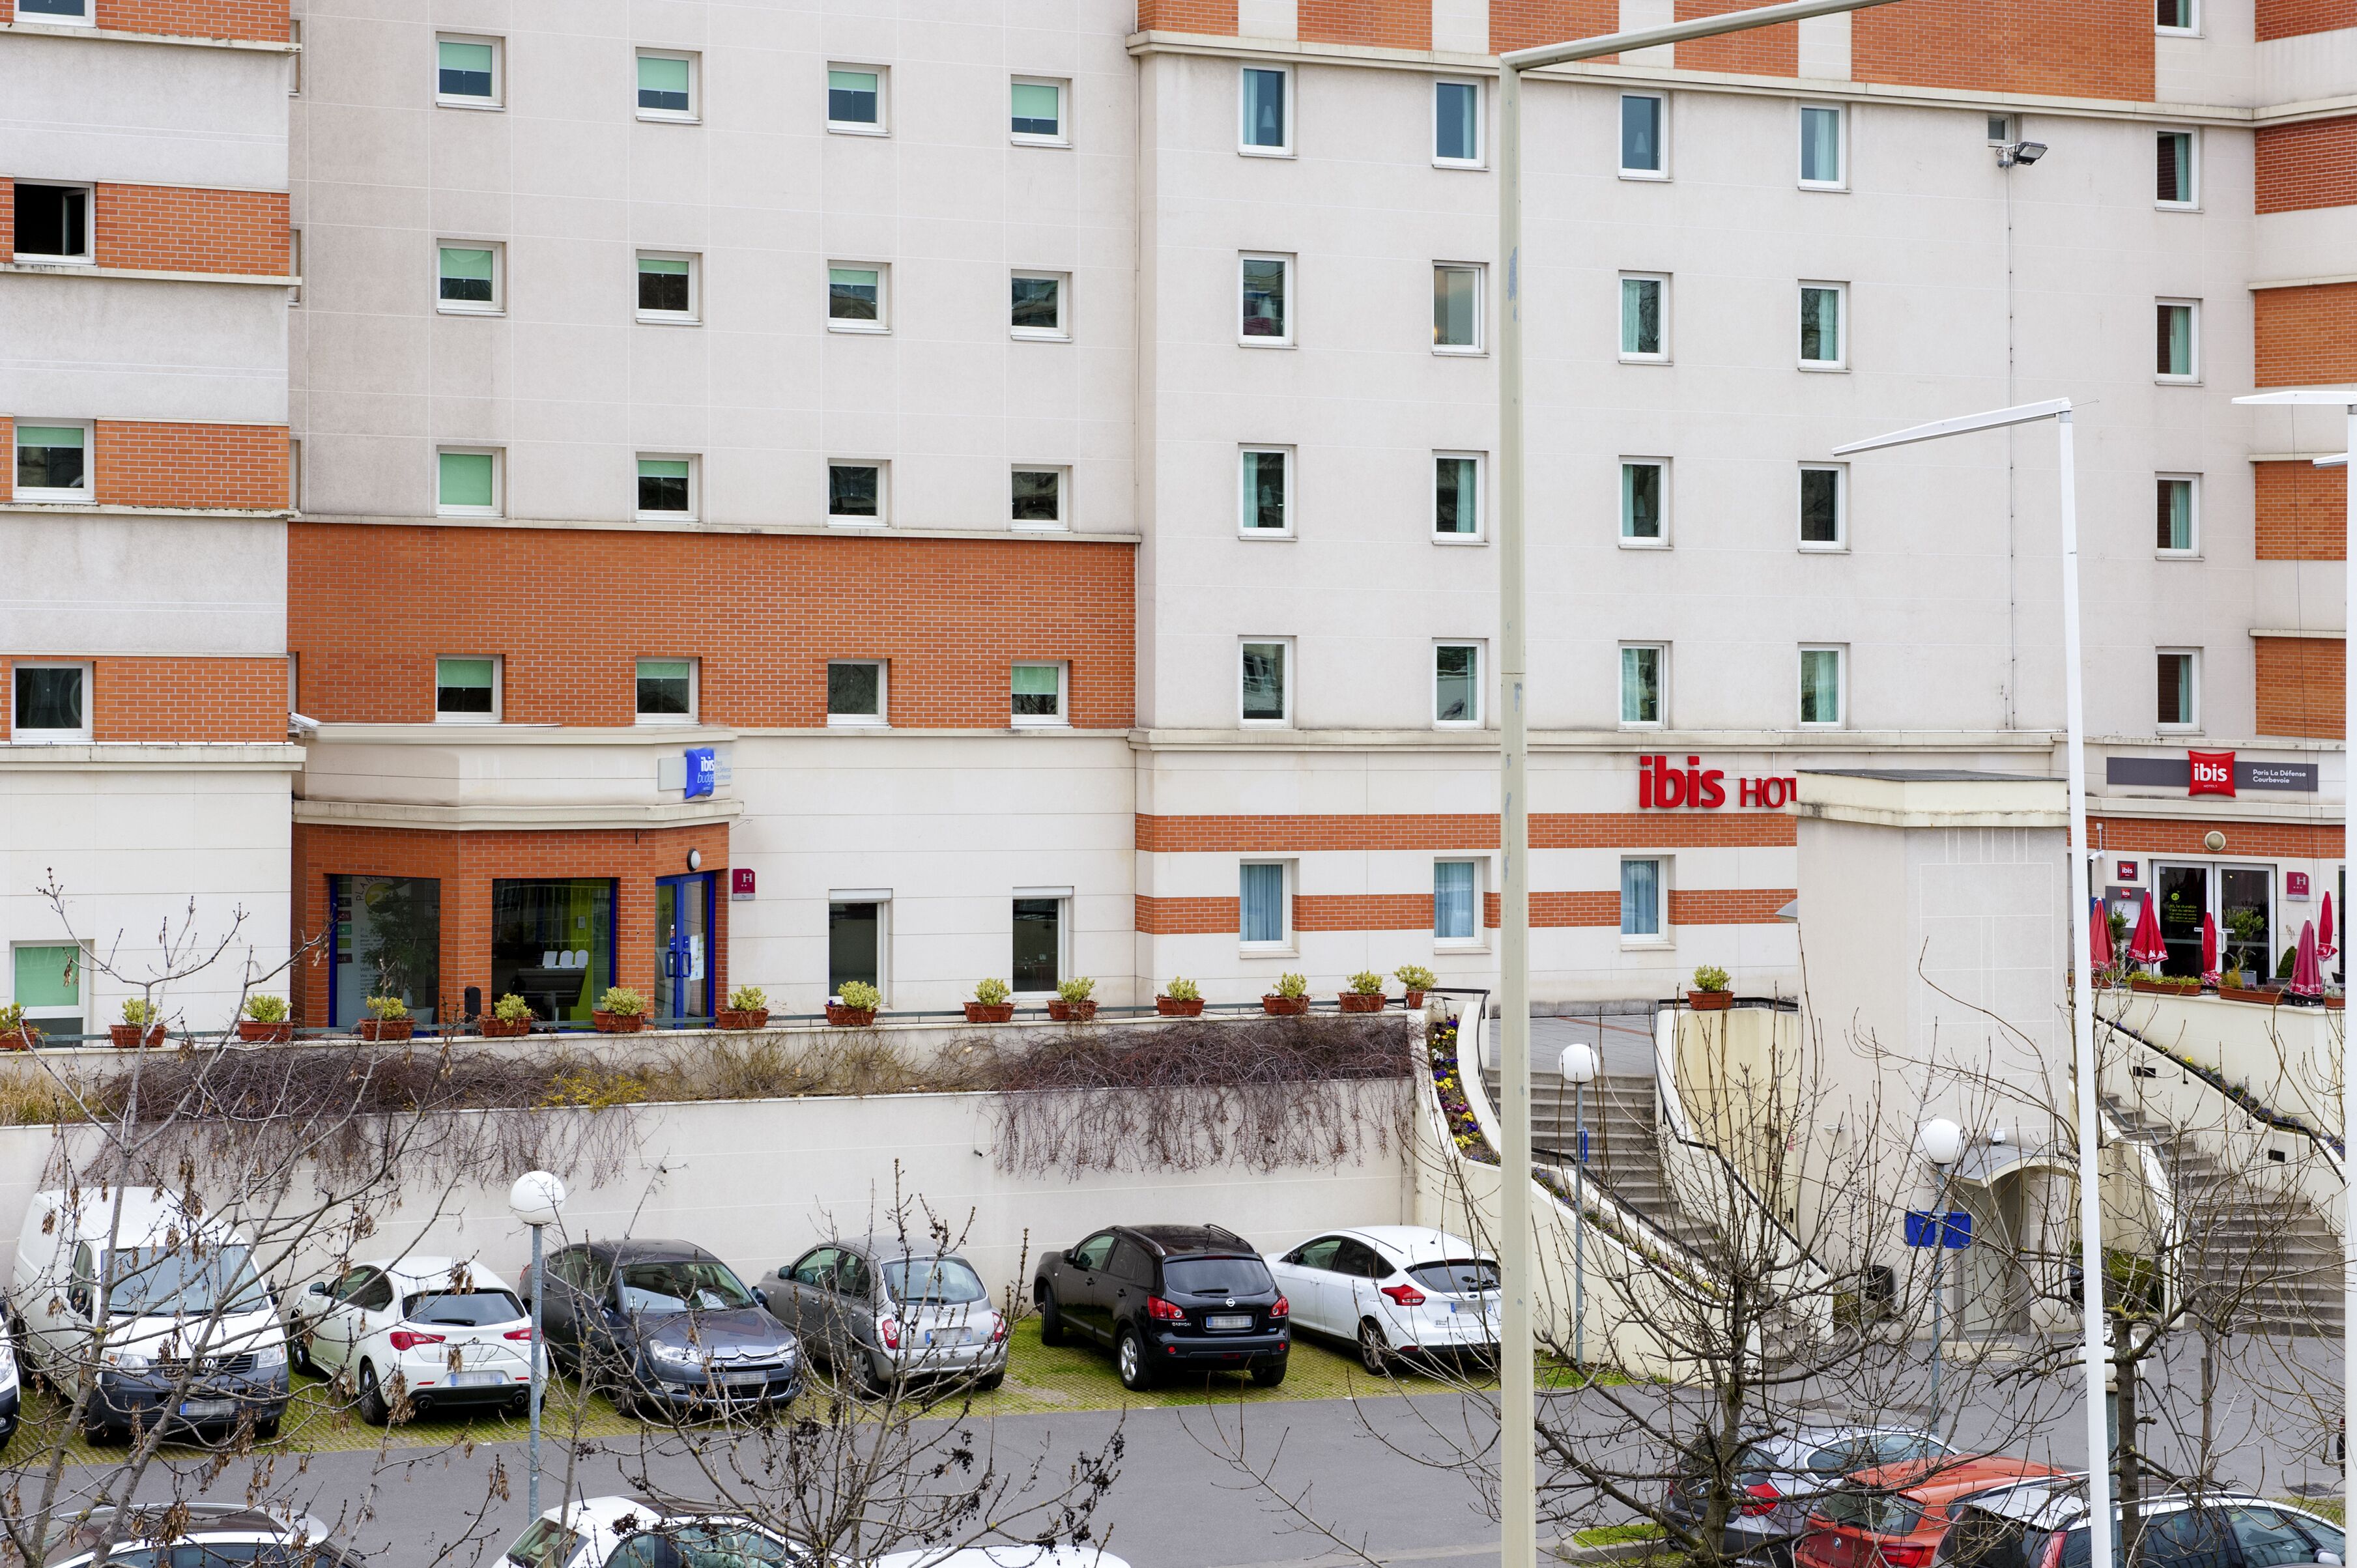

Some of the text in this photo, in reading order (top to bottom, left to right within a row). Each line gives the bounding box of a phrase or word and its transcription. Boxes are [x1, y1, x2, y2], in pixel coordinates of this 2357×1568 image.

[700, 756, 714, 772] ibis
[2194, 763, 2227, 782] ibis
[2280, 769, 2306, 777] Défense
[1639, 756, 1726, 808] ibis
[743, 873, 752, 883] H
[2296, 876, 2306, 885] H
[356, 876, 385, 902] PLANE
